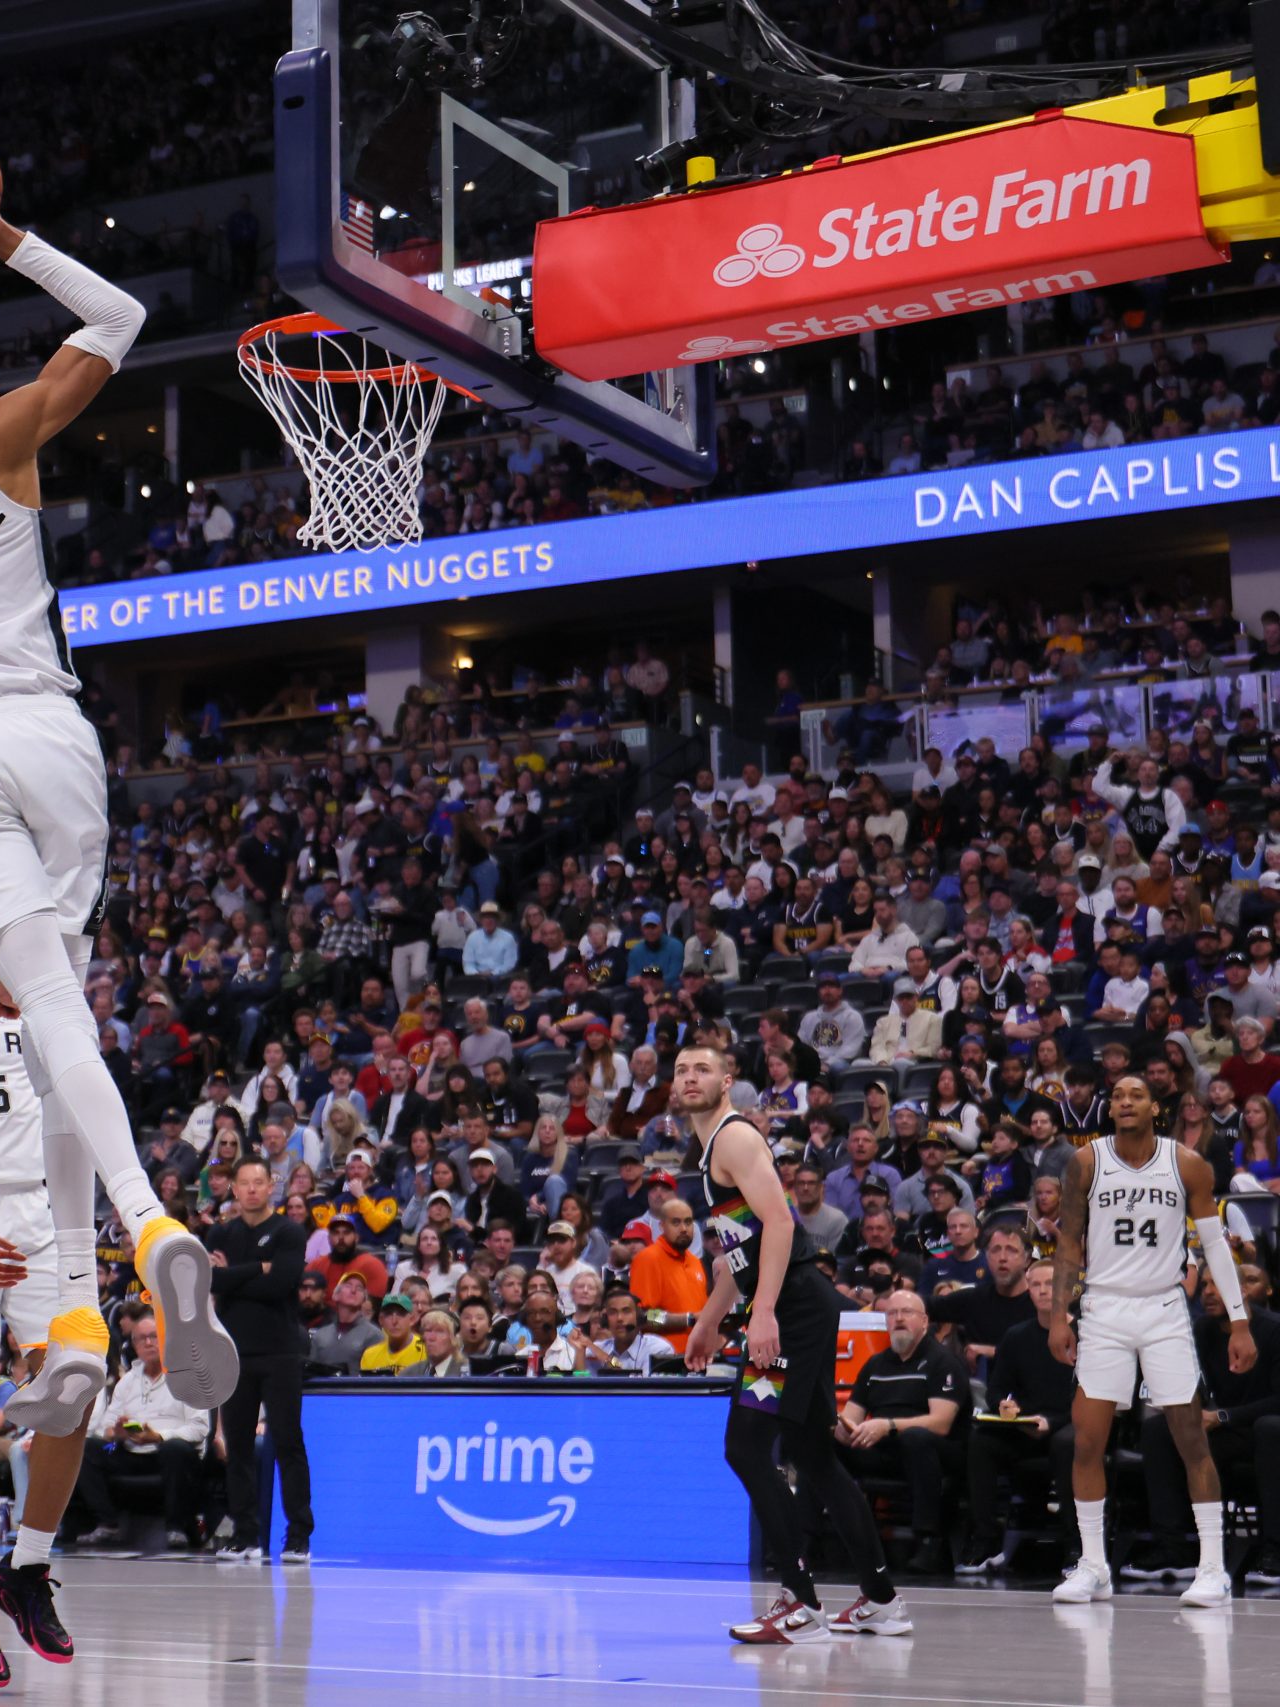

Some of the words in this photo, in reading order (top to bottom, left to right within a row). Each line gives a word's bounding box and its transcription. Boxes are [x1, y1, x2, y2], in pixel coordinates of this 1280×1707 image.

[915, 475, 1022, 528] DAN
[1048, 447, 1241, 510] CAPLIS
[109, 596, 151, 628] OF
[162, 587, 224, 618] THE
[238, 565, 373, 611] DENVER
[386, 541, 554, 591] NUGGETS
[1098, 1187, 1178, 1212] SPURS
[1114, 1218, 1158, 1247] 24
[416, 1421, 594, 1494] prime
